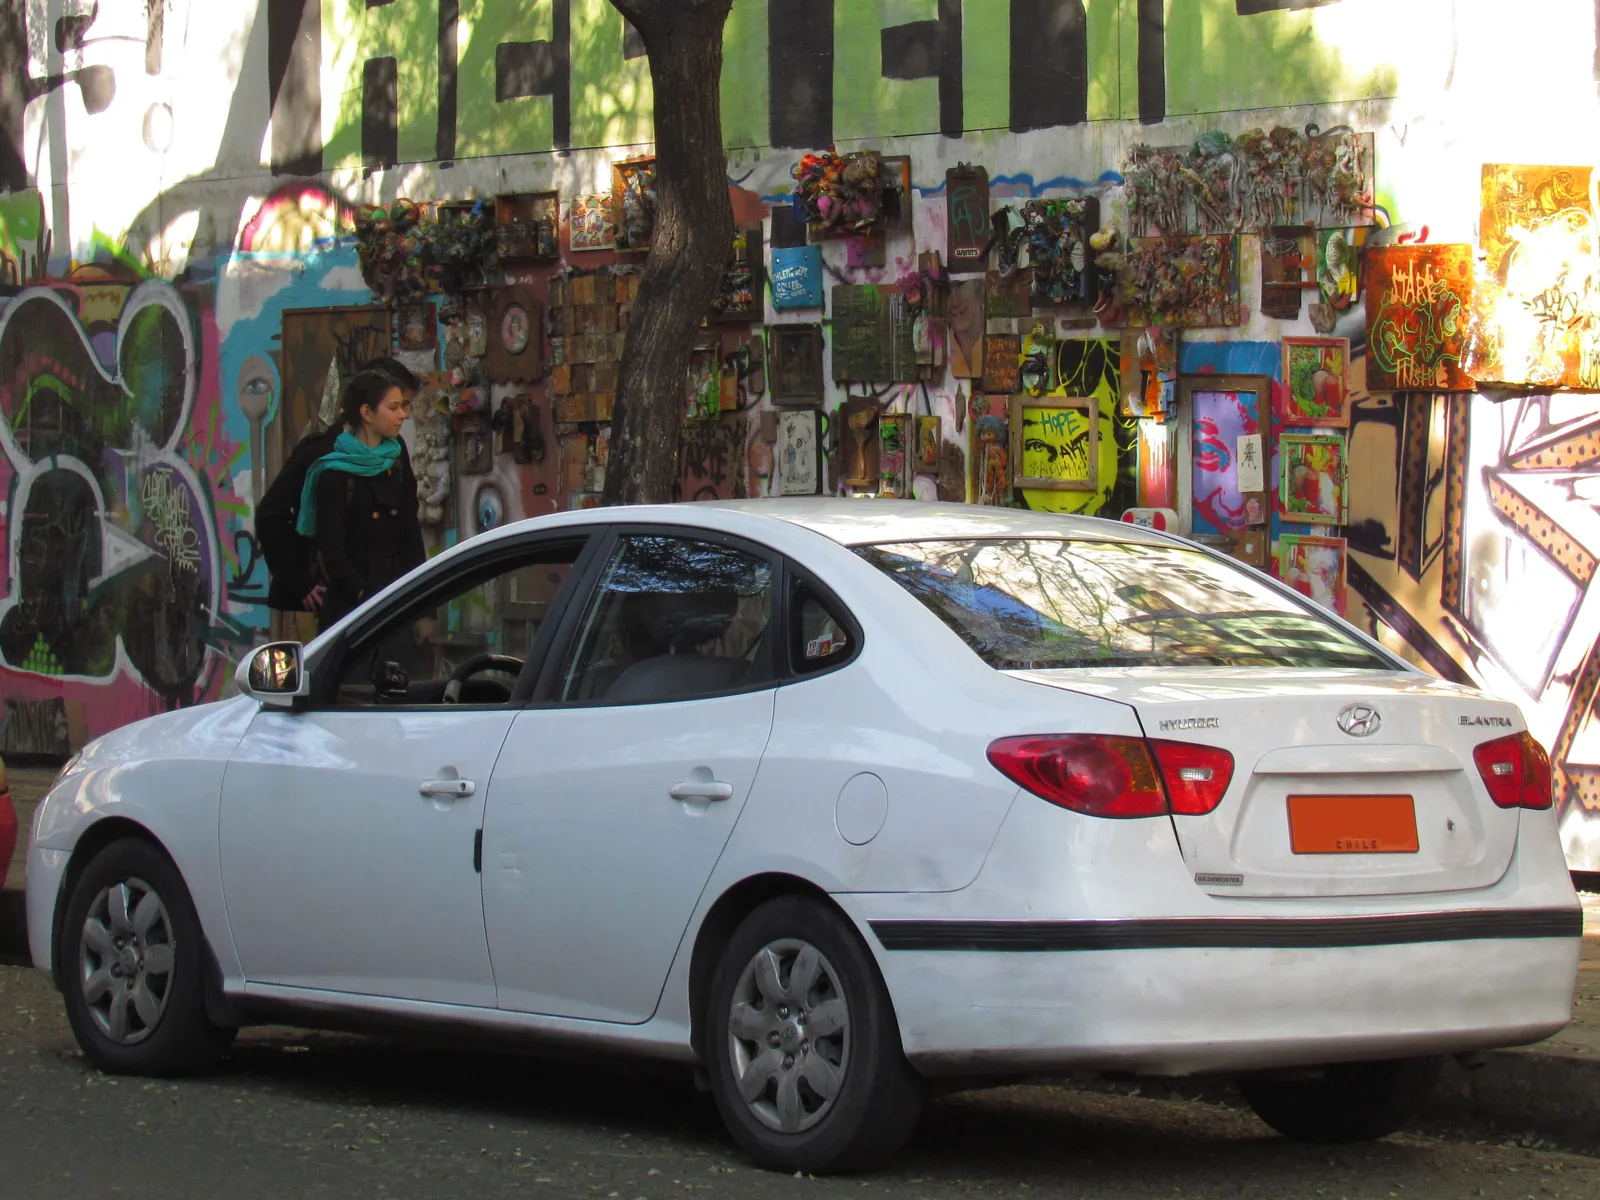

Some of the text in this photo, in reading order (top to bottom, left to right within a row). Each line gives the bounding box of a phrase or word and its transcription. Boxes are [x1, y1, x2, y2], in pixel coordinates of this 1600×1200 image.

[1041, 410, 1080, 438] HOPE
[1159, 717, 1219, 731] HYUNDAI
[1457, 715, 1512, 727] ELANTRA
[1336, 839, 1377, 849] CHILE
